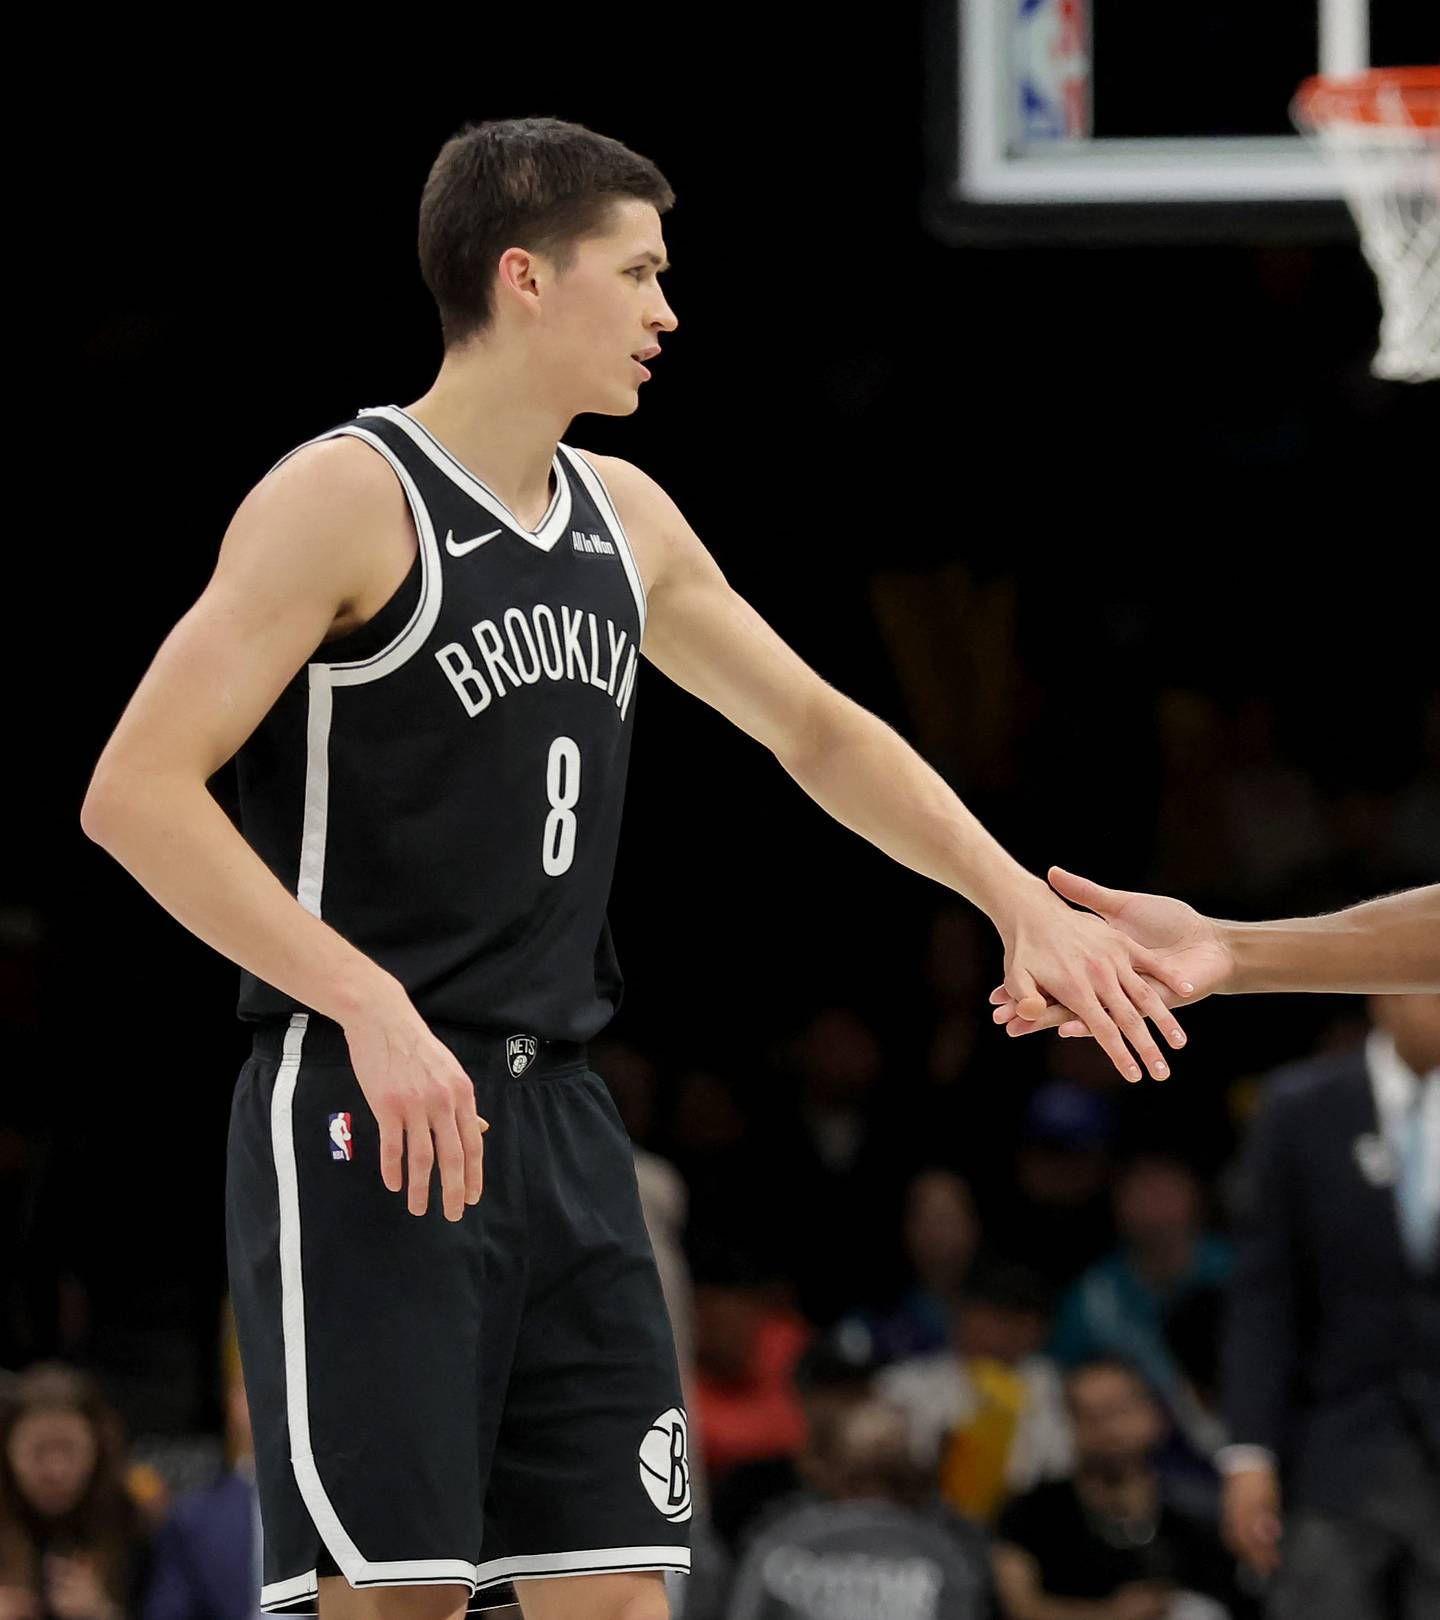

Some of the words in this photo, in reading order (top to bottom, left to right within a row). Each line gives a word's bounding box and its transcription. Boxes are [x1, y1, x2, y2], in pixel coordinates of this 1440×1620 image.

[572, 530, 585, 551] All
[435, 604, 638, 722] BROOKLYN
[542, 736, 581, 877] 8
[510, 1038, 536, 1056] NETS
[667, 1422, 687, 1506] B
